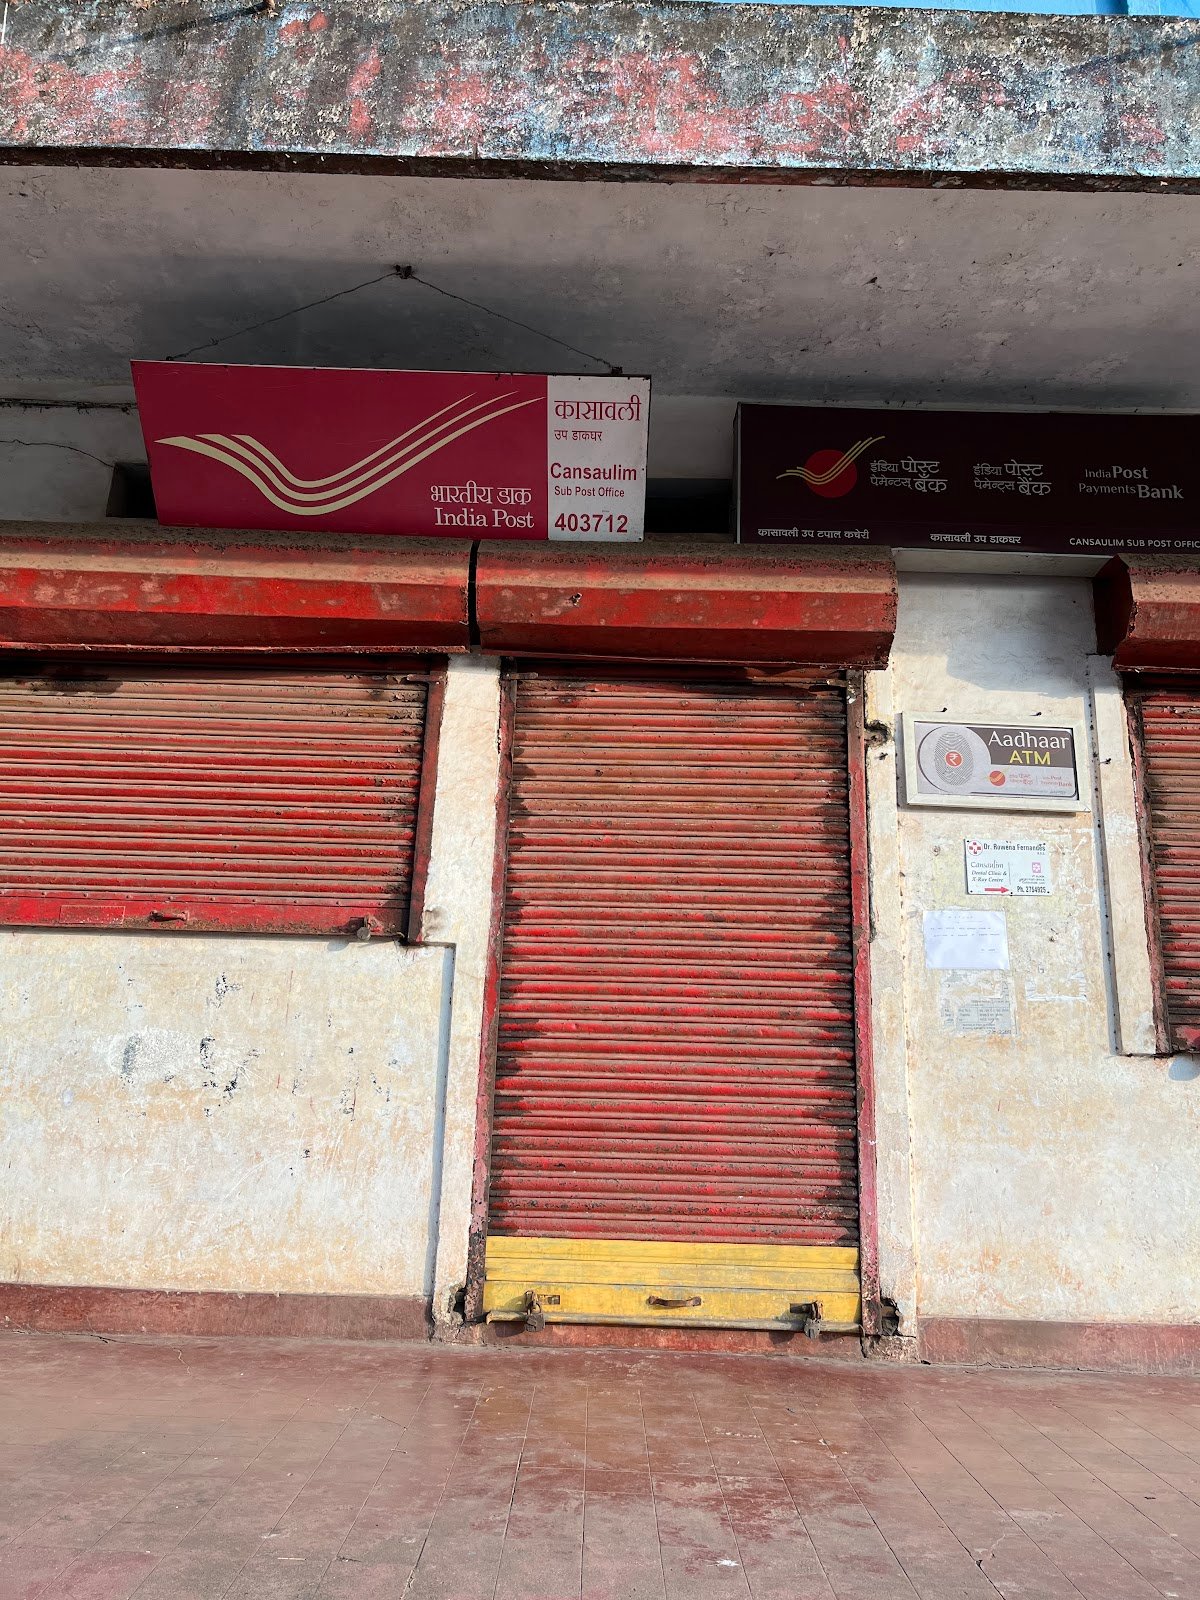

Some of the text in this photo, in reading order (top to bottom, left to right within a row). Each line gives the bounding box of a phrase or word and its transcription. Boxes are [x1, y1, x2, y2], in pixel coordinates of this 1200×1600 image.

[554, 394, 642, 421] कासावली
[554, 429, 603, 442] उप डाकघर
[550, 462, 637, 481] Cansaulim
[869, 455, 941, 474] इंडिया पोस्ट
[973, 459, 1044, 477] इंडिया पोस्ट
[1085, 465, 1149, 479] India Post
[430, 480, 532, 505] भारतीय डाक
[554, 485, 625, 498] Sub Post Office
[1016, 476, 1052, 496] बैंक
[1078, 482, 1185, 499] Payments Bank
[434, 507, 535, 528] India Post
[554, 512, 628, 534] 403712
[757, 527, 799, 538] कासावली
[801, 529, 815, 538] उप
[816, 530, 842, 539] टपाल
[929, 531, 1022, 544] कासावली उप डाकघर
[1069, 538, 1200, 549] CANSAULIM SUB POST OFFIC
[988, 730, 1070, 749] Aadhaar
[1009, 749, 1051, 765] ATM
